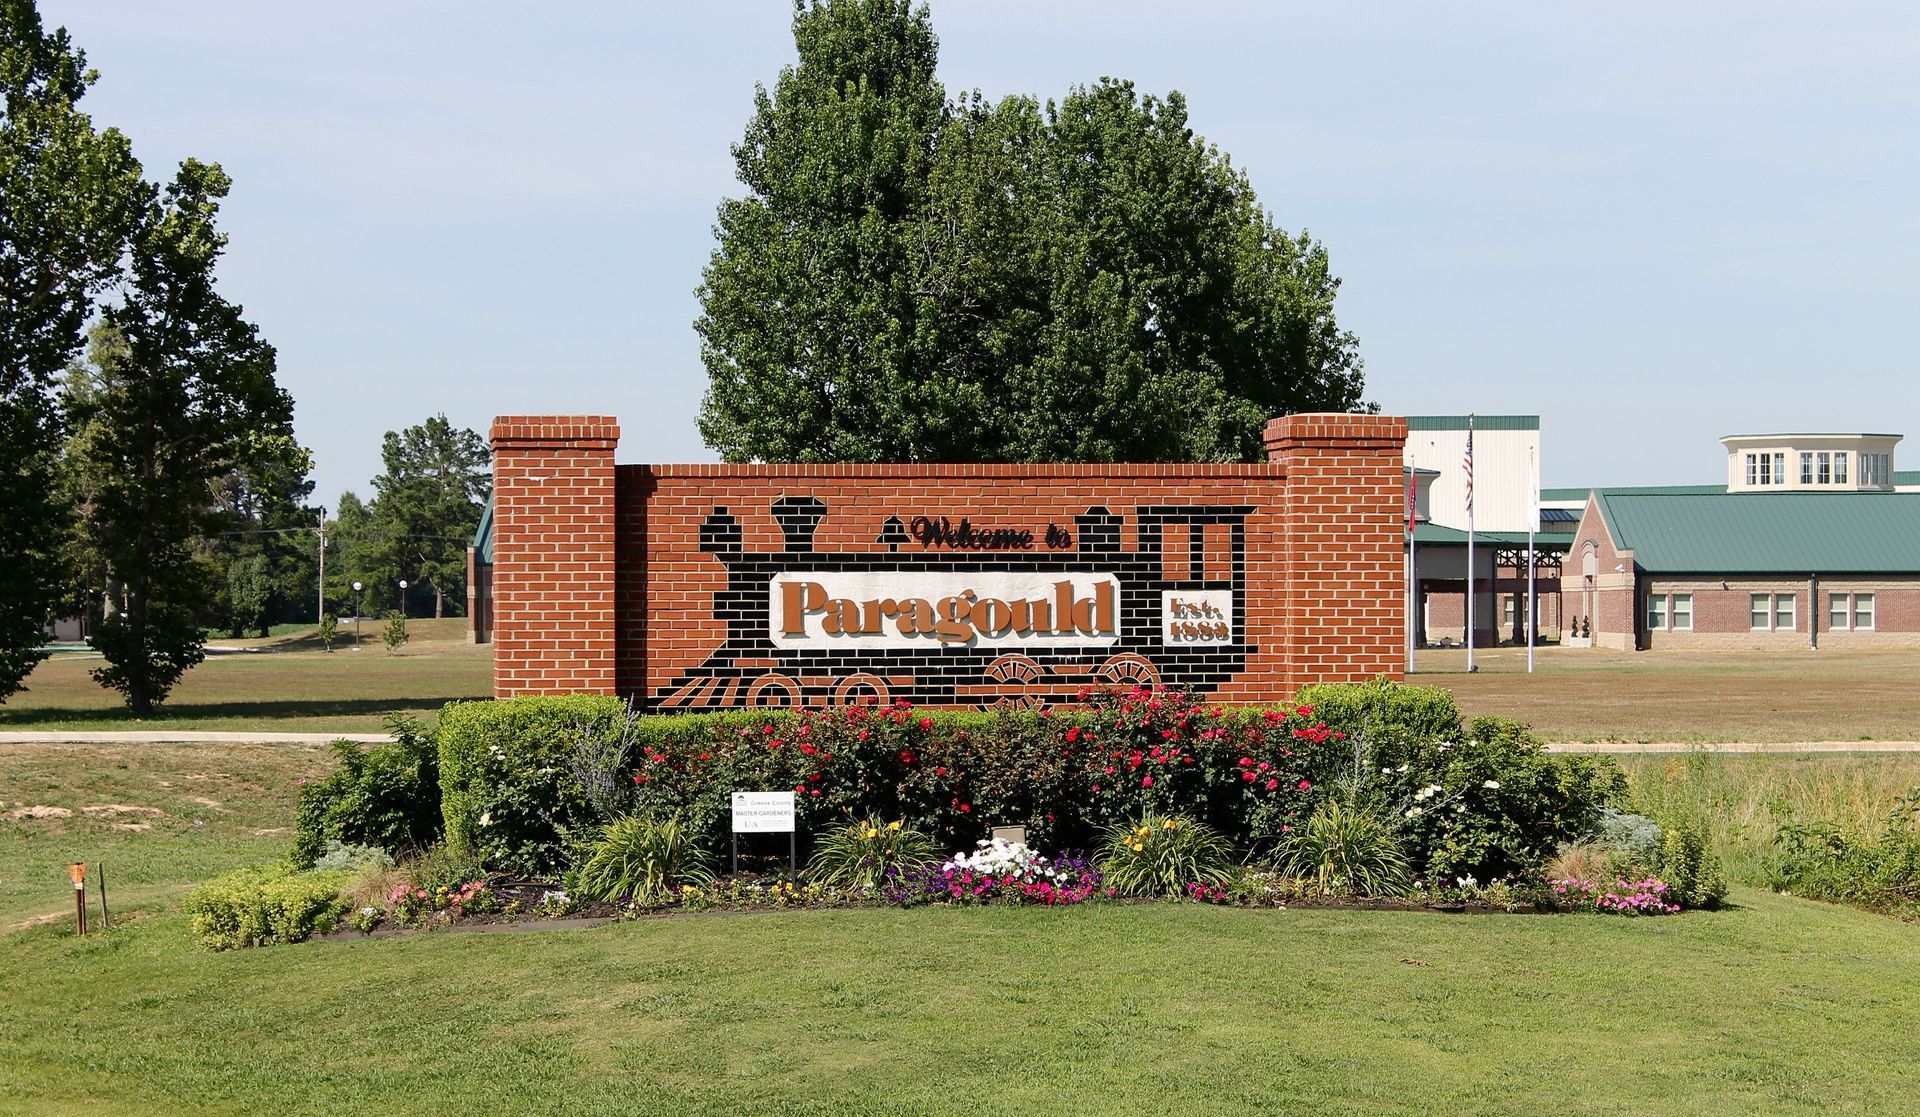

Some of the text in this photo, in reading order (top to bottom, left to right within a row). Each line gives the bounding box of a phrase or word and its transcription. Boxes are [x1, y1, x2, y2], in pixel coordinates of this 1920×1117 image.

[911, 516, 1073, 549] Welcome to
[778, 580, 1115, 646] Paragould
[1170, 598, 1223, 619] Est.
[1170, 621, 1229, 641] 1883
